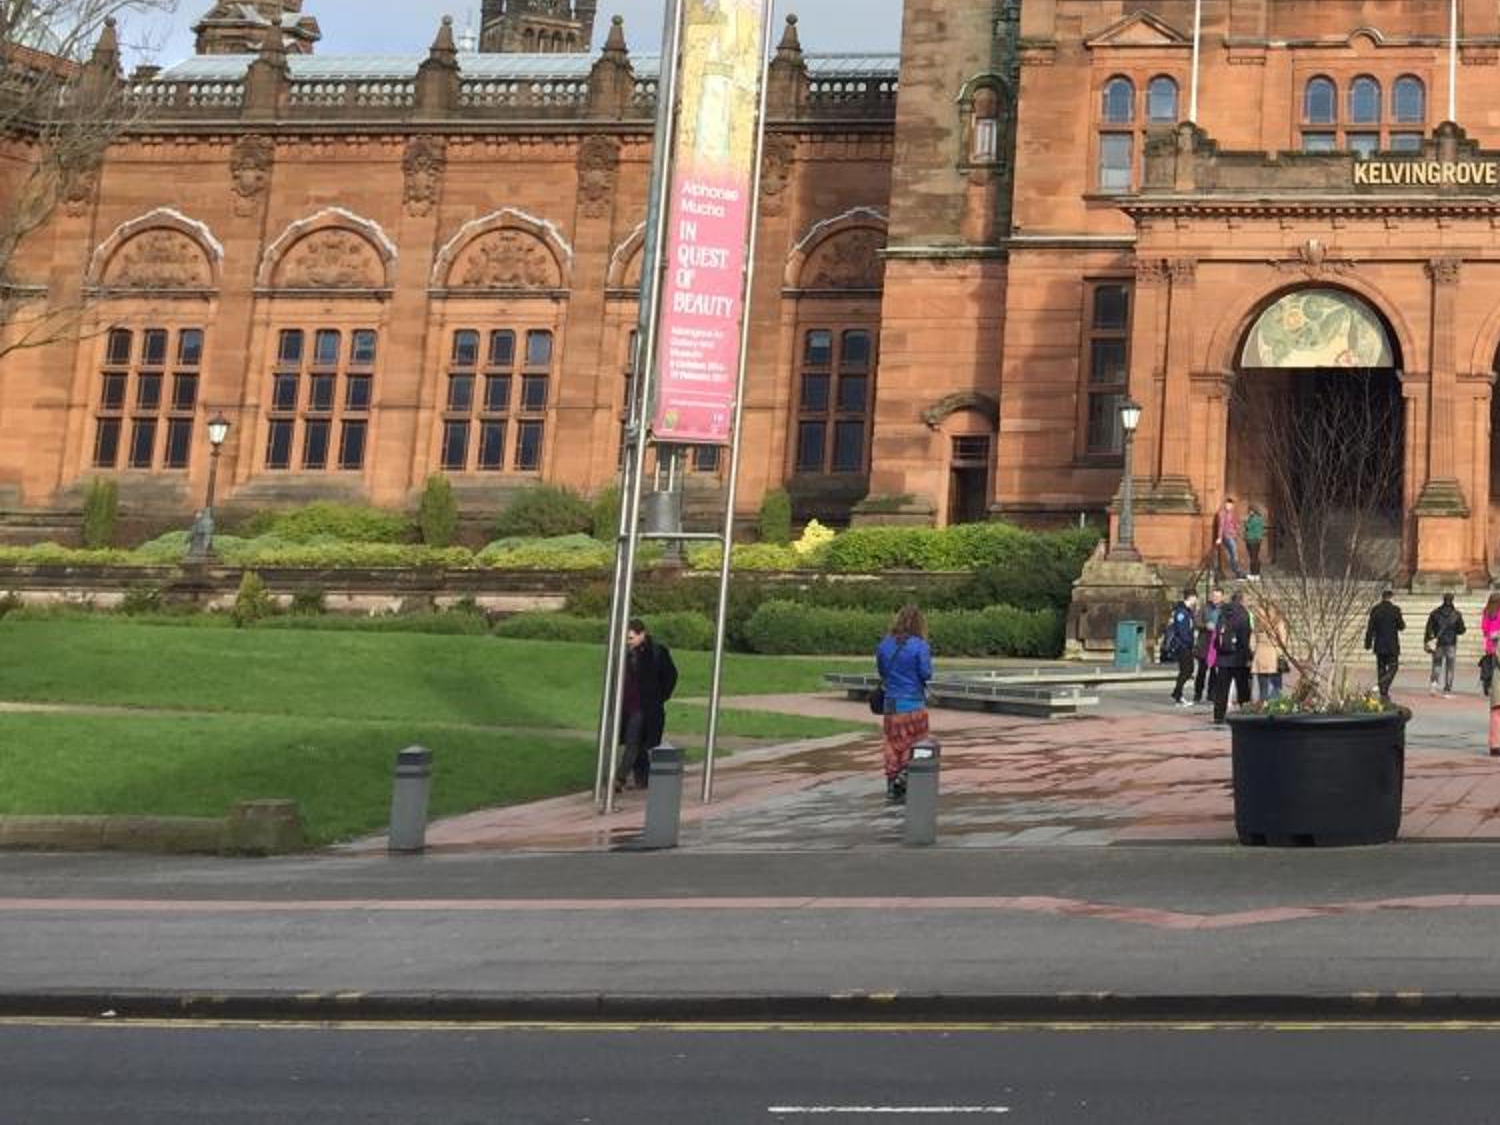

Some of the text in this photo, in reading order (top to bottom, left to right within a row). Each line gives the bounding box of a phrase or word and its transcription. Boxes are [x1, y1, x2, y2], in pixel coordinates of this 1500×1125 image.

[1354, 162, 1498, 184] KELVINGROVE
[681, 180, 739, 201] Alphonse
[680, 198, 725, 217] Mucha
[679, 221, 696, 241] IN
[677, 244, 729, 268] QUEST
[675, 268, 696, 288] OF
[672, 291, 733, 317] BEAUTY
